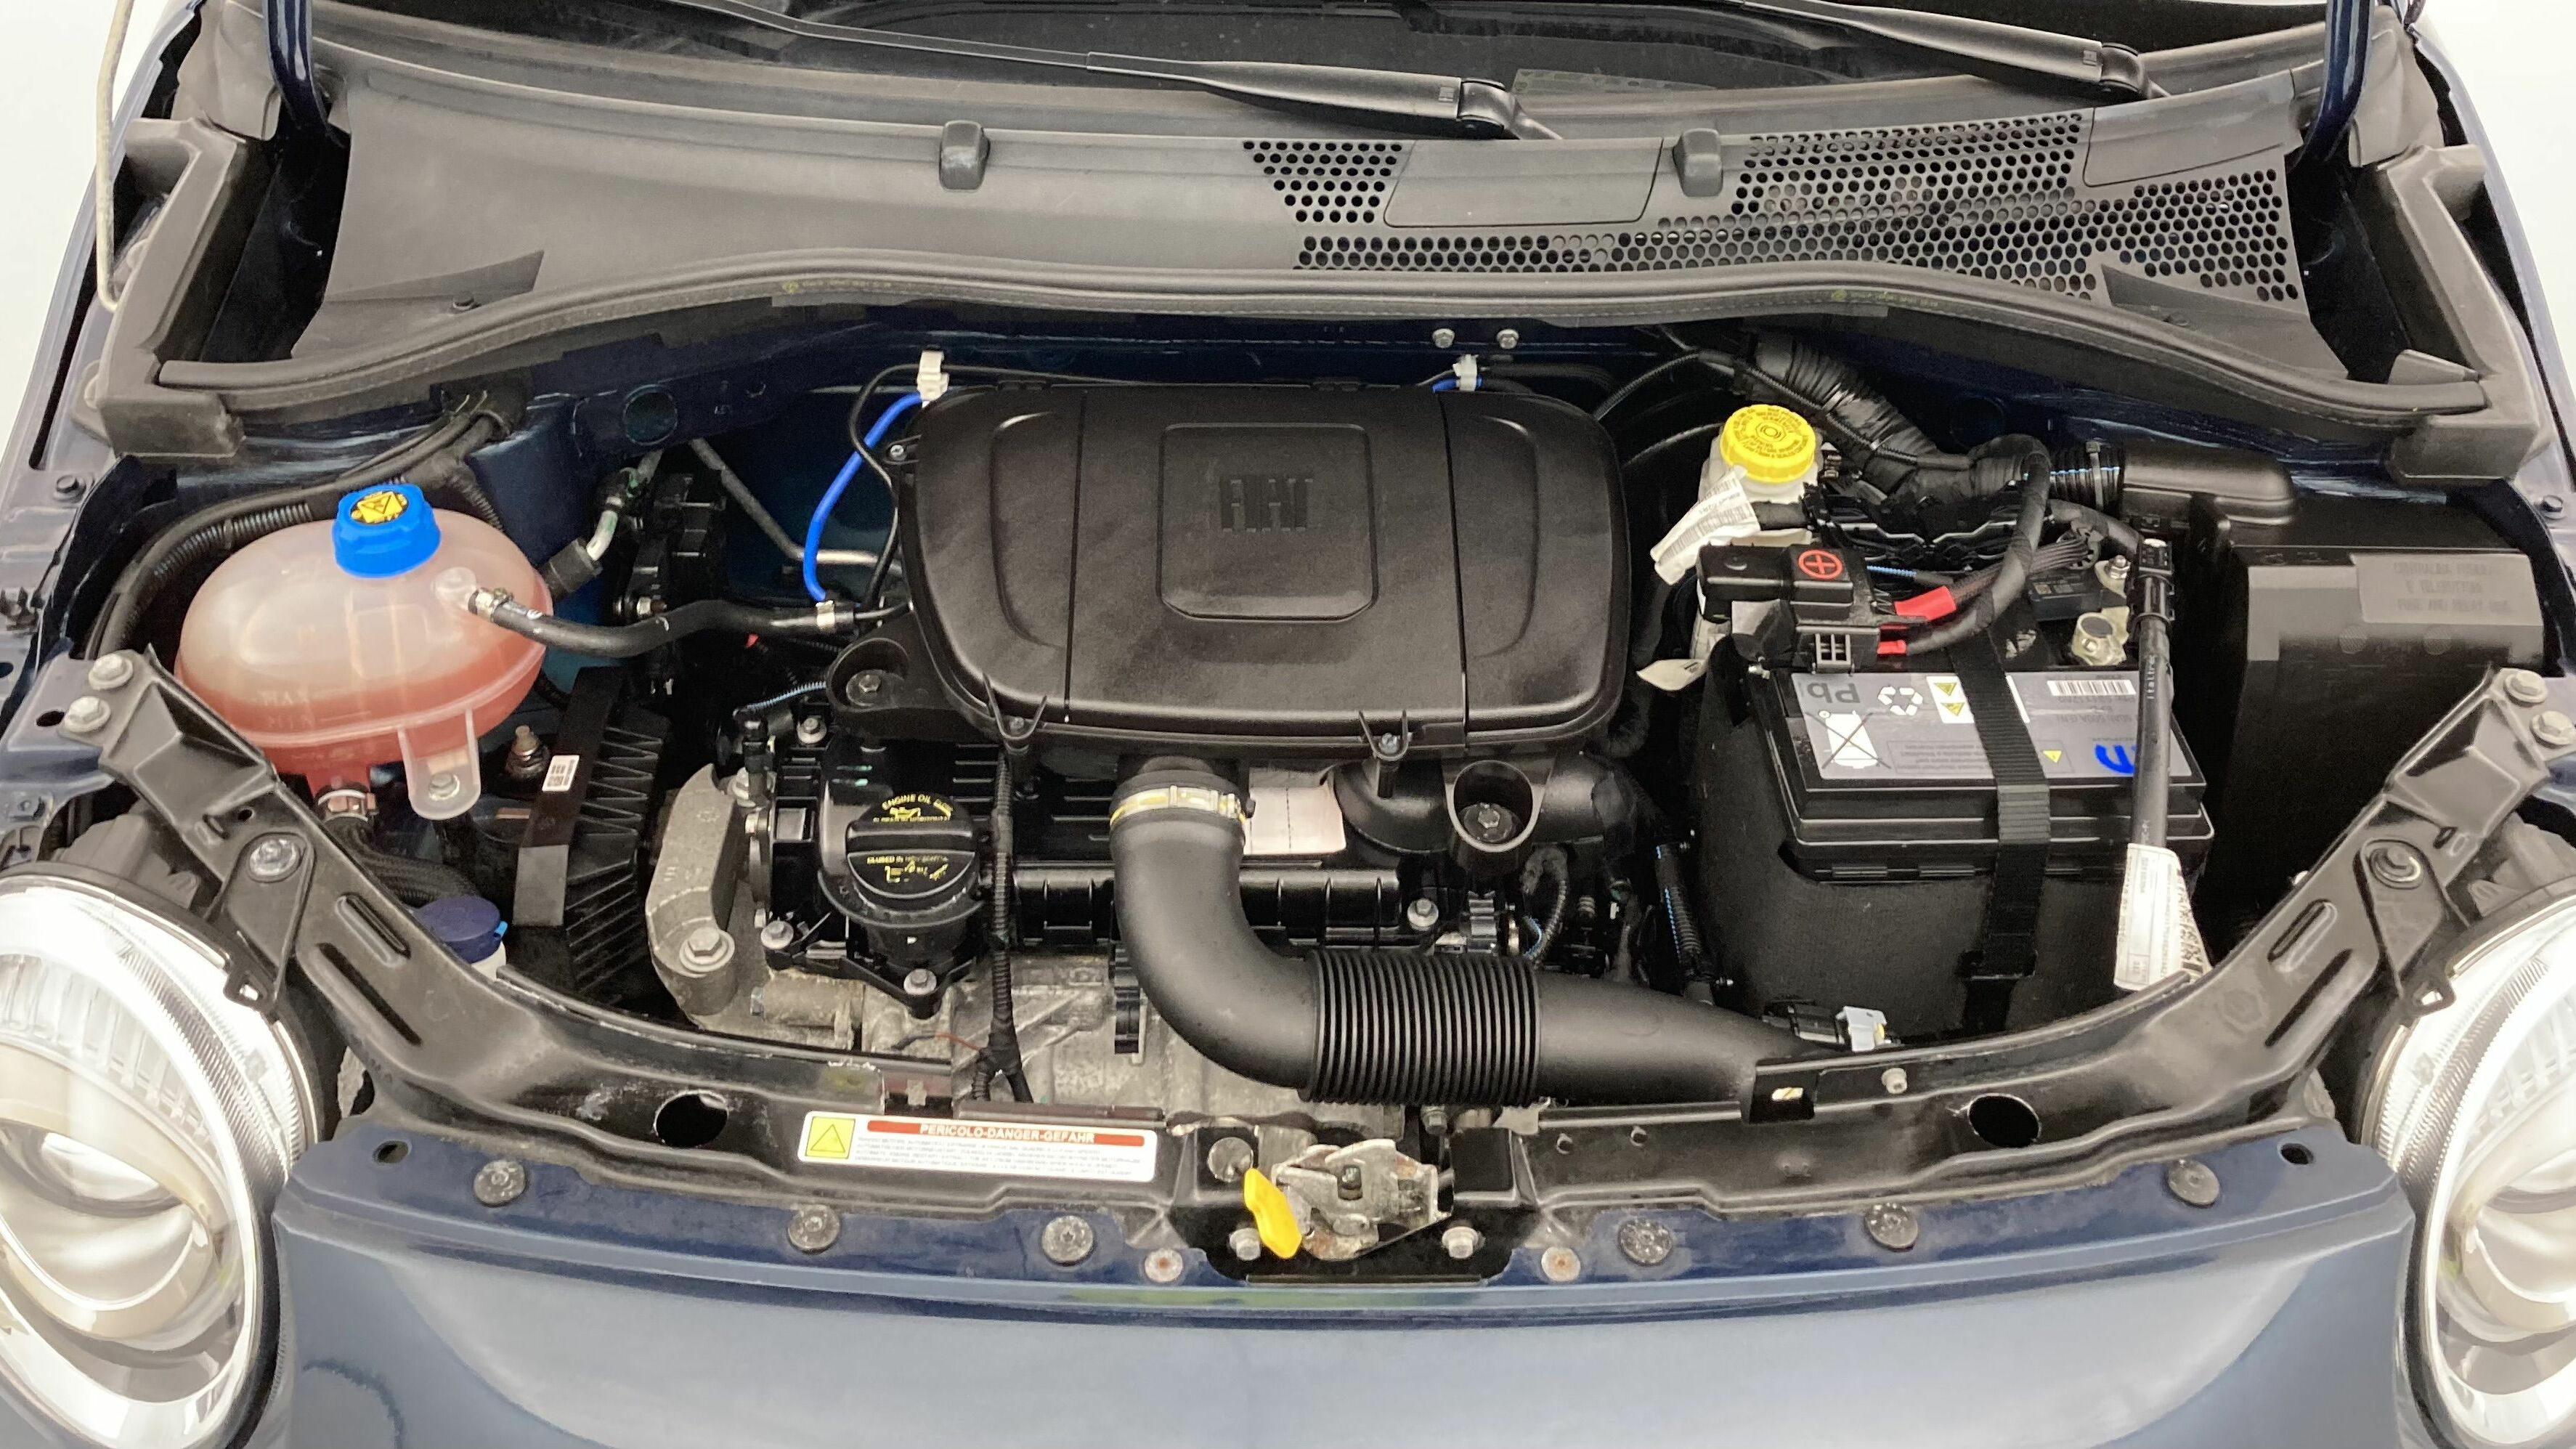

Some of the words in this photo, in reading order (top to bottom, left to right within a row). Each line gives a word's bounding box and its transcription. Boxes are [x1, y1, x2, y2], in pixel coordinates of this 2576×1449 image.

[1807, 683, 1861, 704] Pb
[882, 793, 917, 811] ENGINE
[917, 793, 931, 805] OIL
[919, 1123, 1095, 1143] PERICOLO-DANGER-GEFAHR
